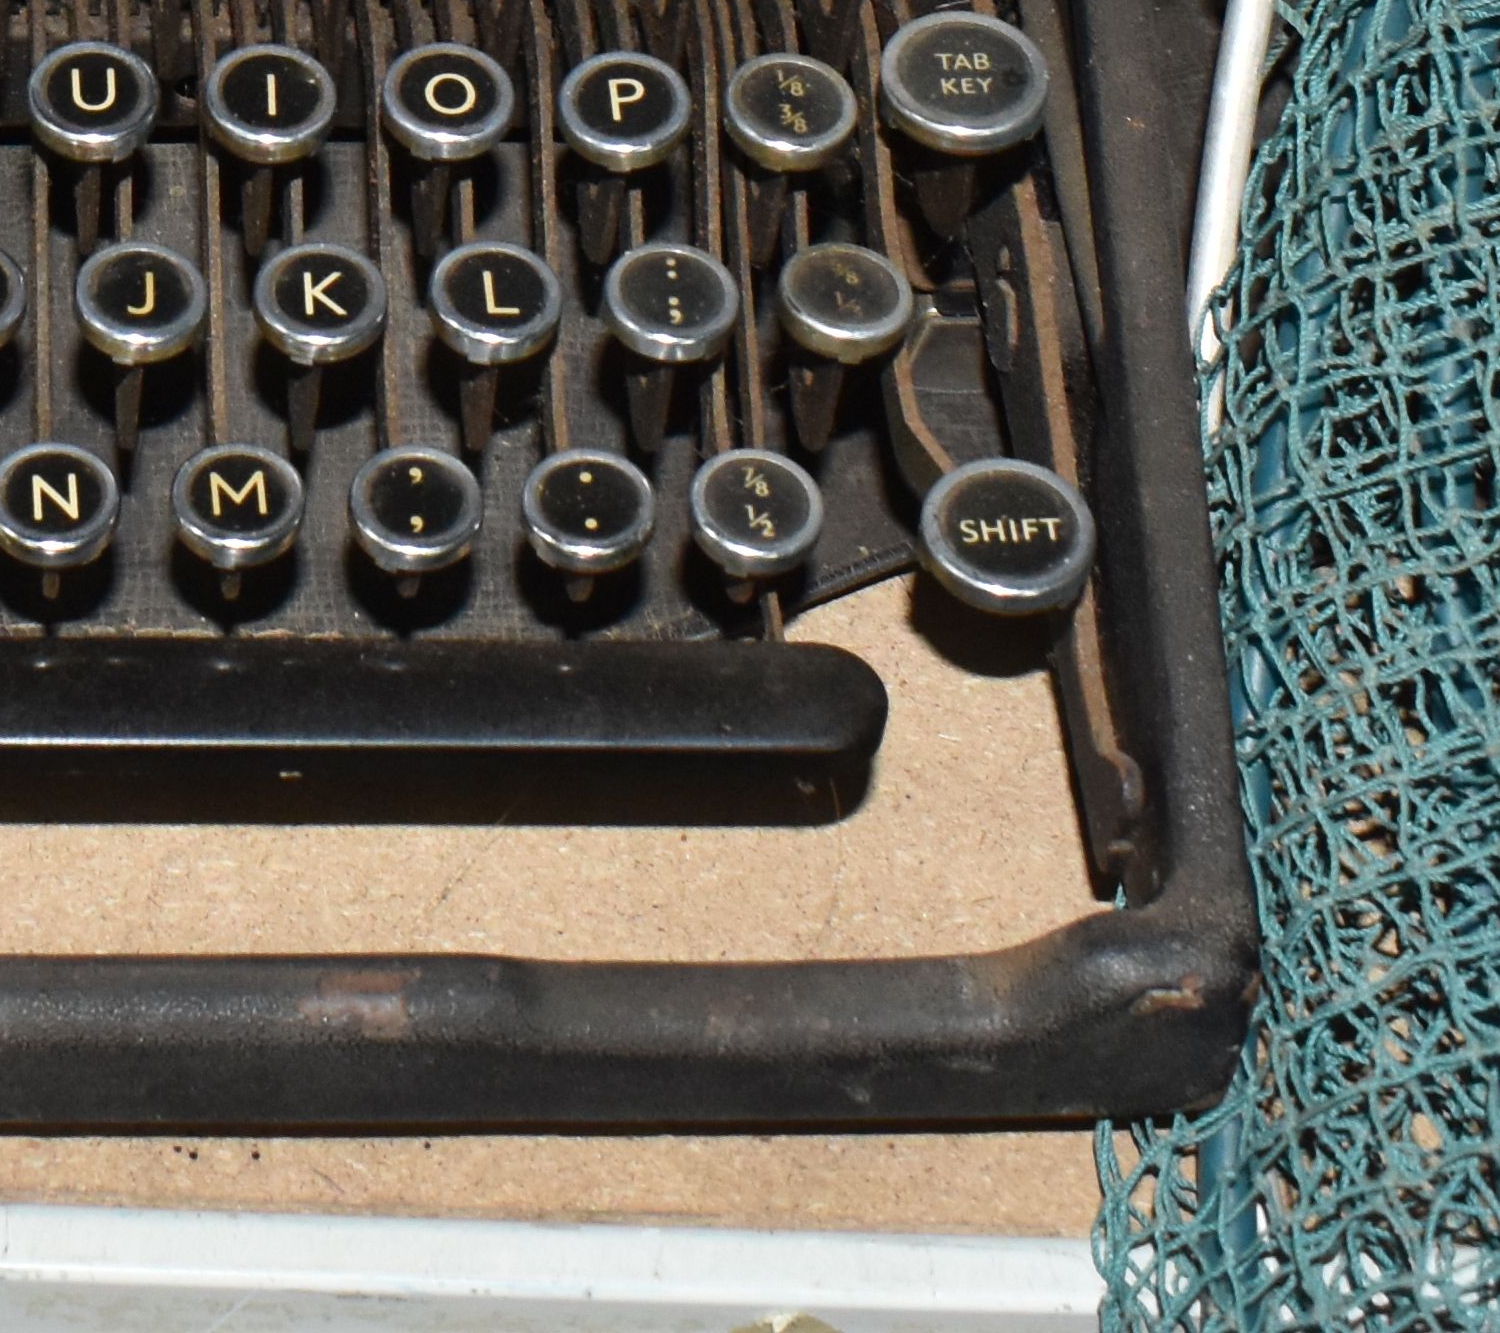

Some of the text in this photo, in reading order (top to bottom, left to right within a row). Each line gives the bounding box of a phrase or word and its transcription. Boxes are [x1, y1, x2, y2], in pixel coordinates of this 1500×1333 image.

[935, 51, 991, 72] TAB
[71, 68, 116, 111] U
[424, 72, 476, 115] O
[607, 78, 645, 121] P
[940, 76, 994, 96] KEY
[127, 271, 154, 315] J
[303, 271, 348, 316] K
[482, 270, 520, 315] L
[31, 473, 79, 521] N
[209, 471, 268, 516] M
[960, 517, 1062, 544] SHIFT
